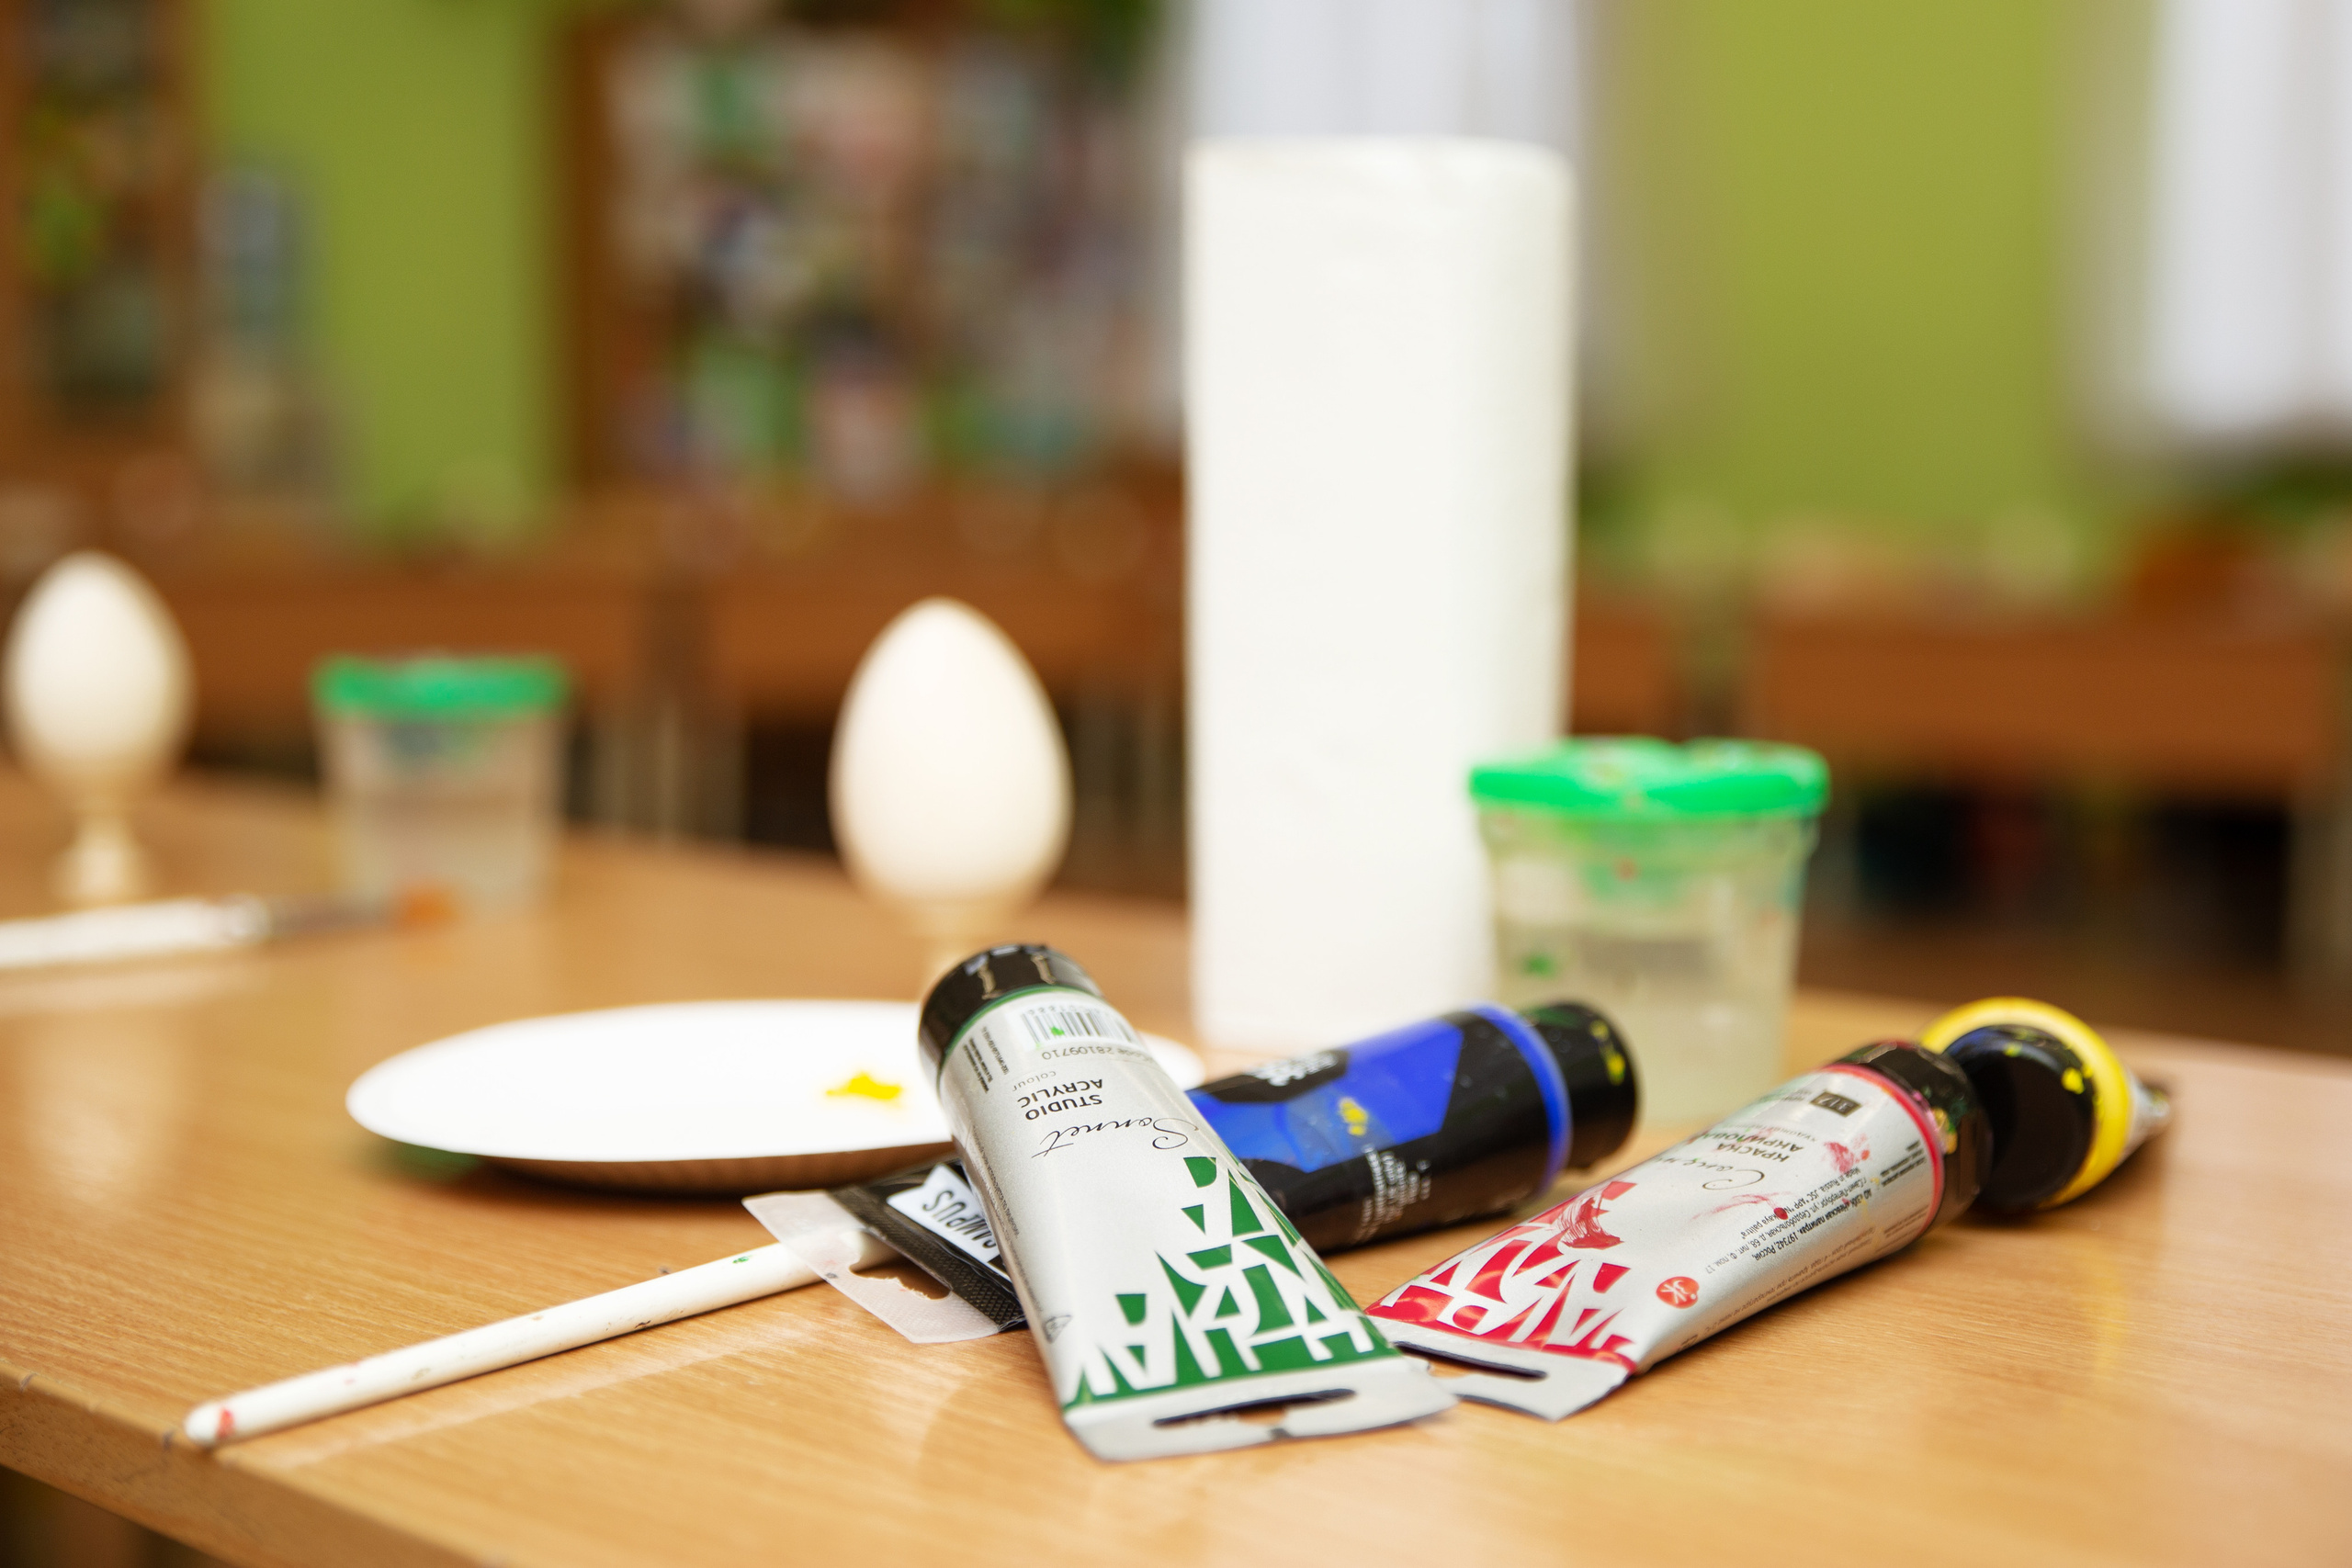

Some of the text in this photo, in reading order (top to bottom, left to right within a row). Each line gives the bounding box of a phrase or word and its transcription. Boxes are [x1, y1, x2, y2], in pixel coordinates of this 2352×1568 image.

[1012, 1070, 1057, 1092] colour
[1017, 1078, 1103, 1109] ACRYLIC
[1024, 1094, 1103, 1121] STUDIO
[1031, 1116, 1200, 1158] Sonnet
[1716, 1143, 1790, 1163] КРАСКА
[1807, 1190, 1819, 1201] JSC
